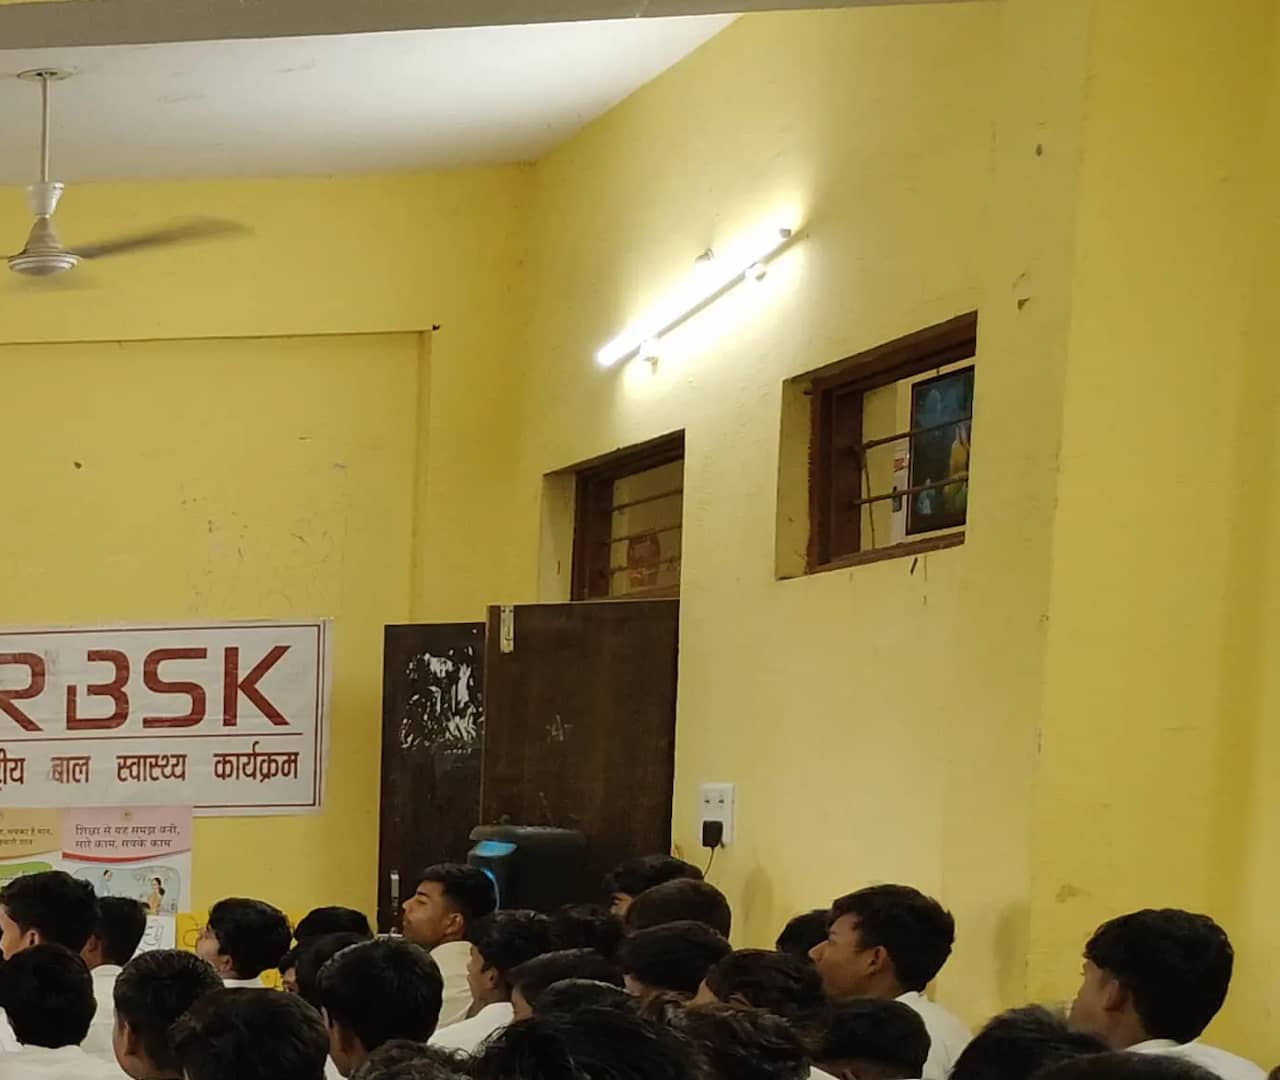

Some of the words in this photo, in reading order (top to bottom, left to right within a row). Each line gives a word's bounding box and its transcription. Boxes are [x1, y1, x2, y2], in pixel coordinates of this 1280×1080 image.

[51, 756, 90, 785] बाल
[116, 753, 187, 783] स्वास्थ्य
[213, 741, 300, 783] कार्यक्रम
